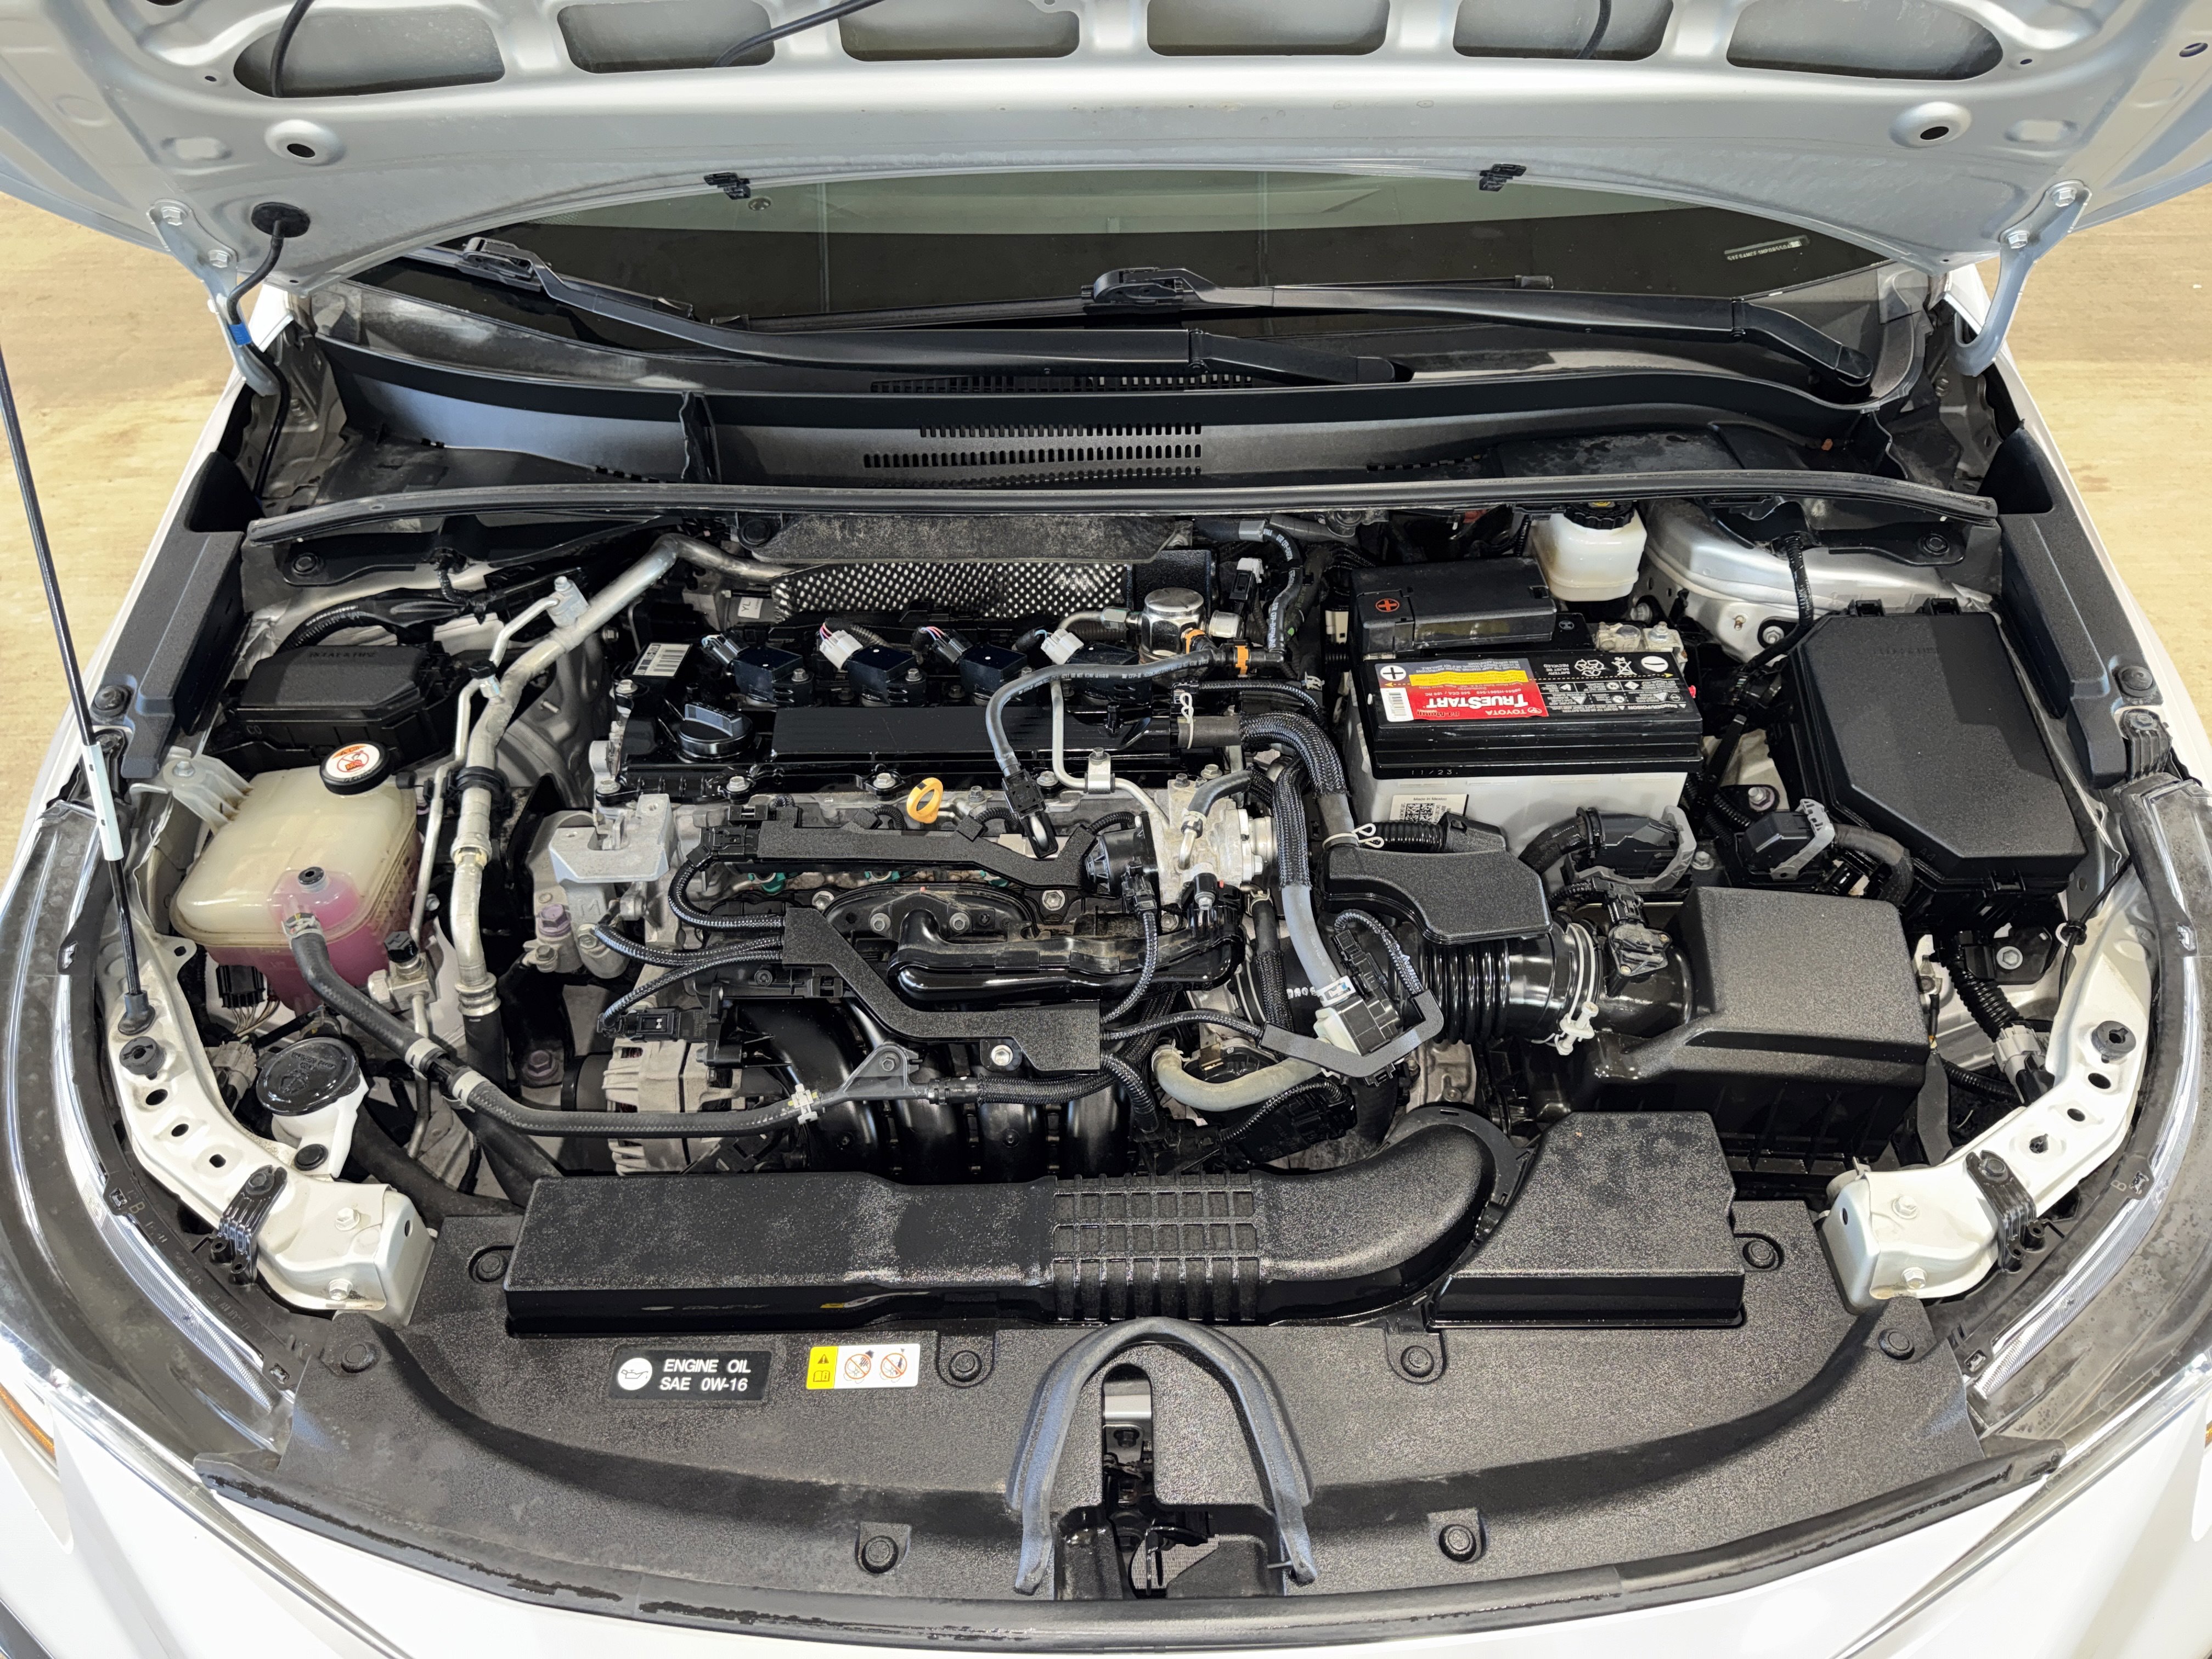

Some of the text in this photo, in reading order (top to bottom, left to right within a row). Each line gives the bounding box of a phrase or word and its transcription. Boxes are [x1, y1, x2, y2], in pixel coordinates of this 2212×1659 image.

[2110, 1180, 2127, 1192] B
[128, 1201, 145, 1214] B
[663, 1358, 751, 1373] ENGINE OIL
[659, 1376, 748, 1392] SAE 0W-16
